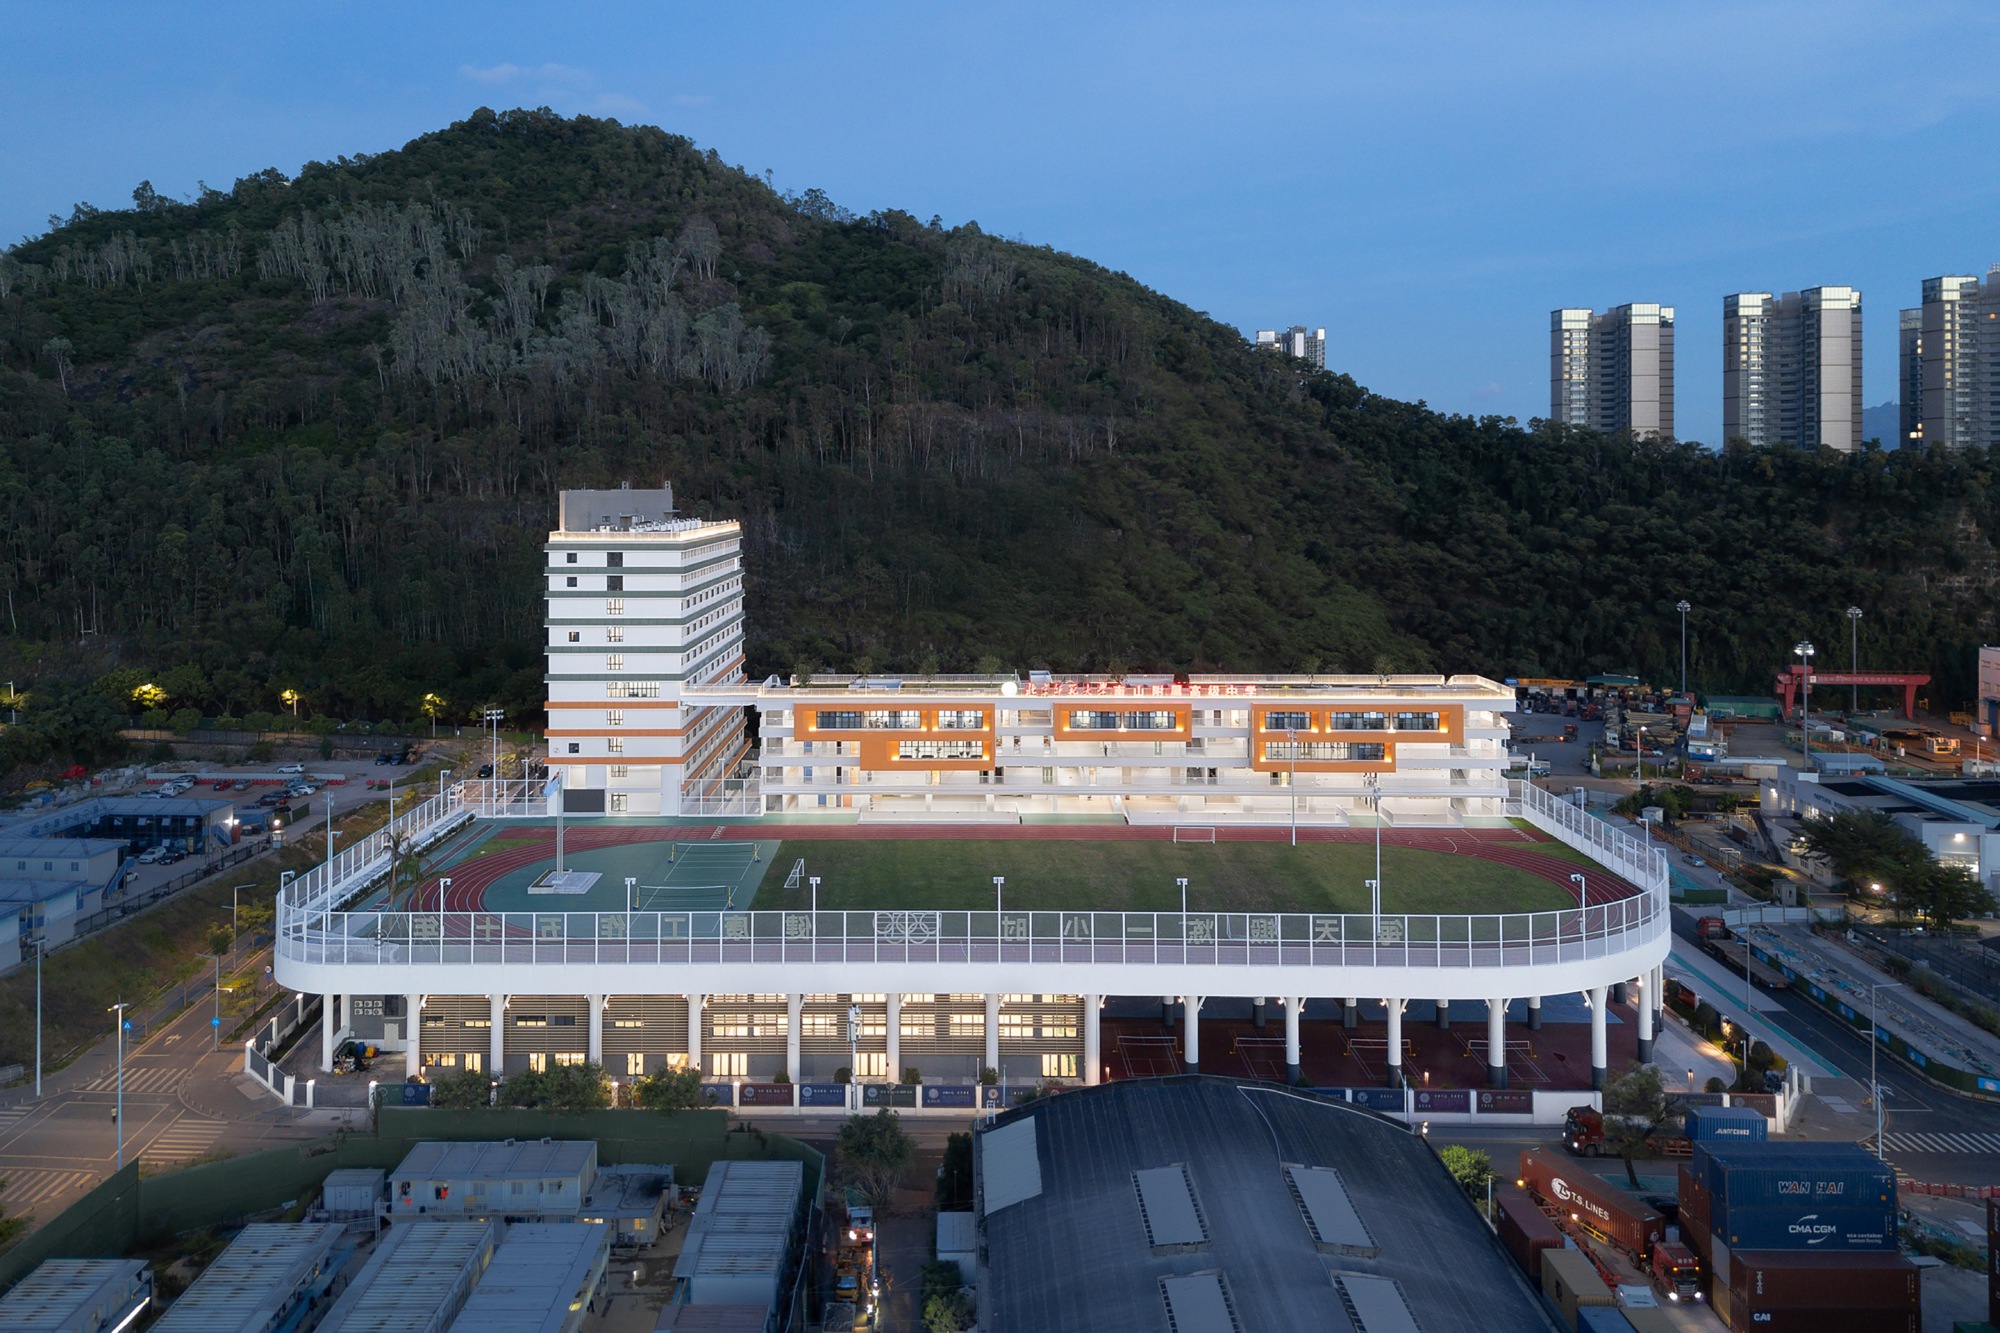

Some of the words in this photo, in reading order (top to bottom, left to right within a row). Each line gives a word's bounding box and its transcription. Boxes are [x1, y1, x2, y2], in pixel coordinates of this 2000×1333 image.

[1778, 1181, 1811, 1194] WAN
[1816, 1182, 1844, 1194] HAI
[1585, 1200, 1610, 1221] LINES
[1788, 1225, 1812, 1234] CMA
[1813, 1225, 1837, 1234] CGM
[1753, 1313, 1771, 1321] CAI
